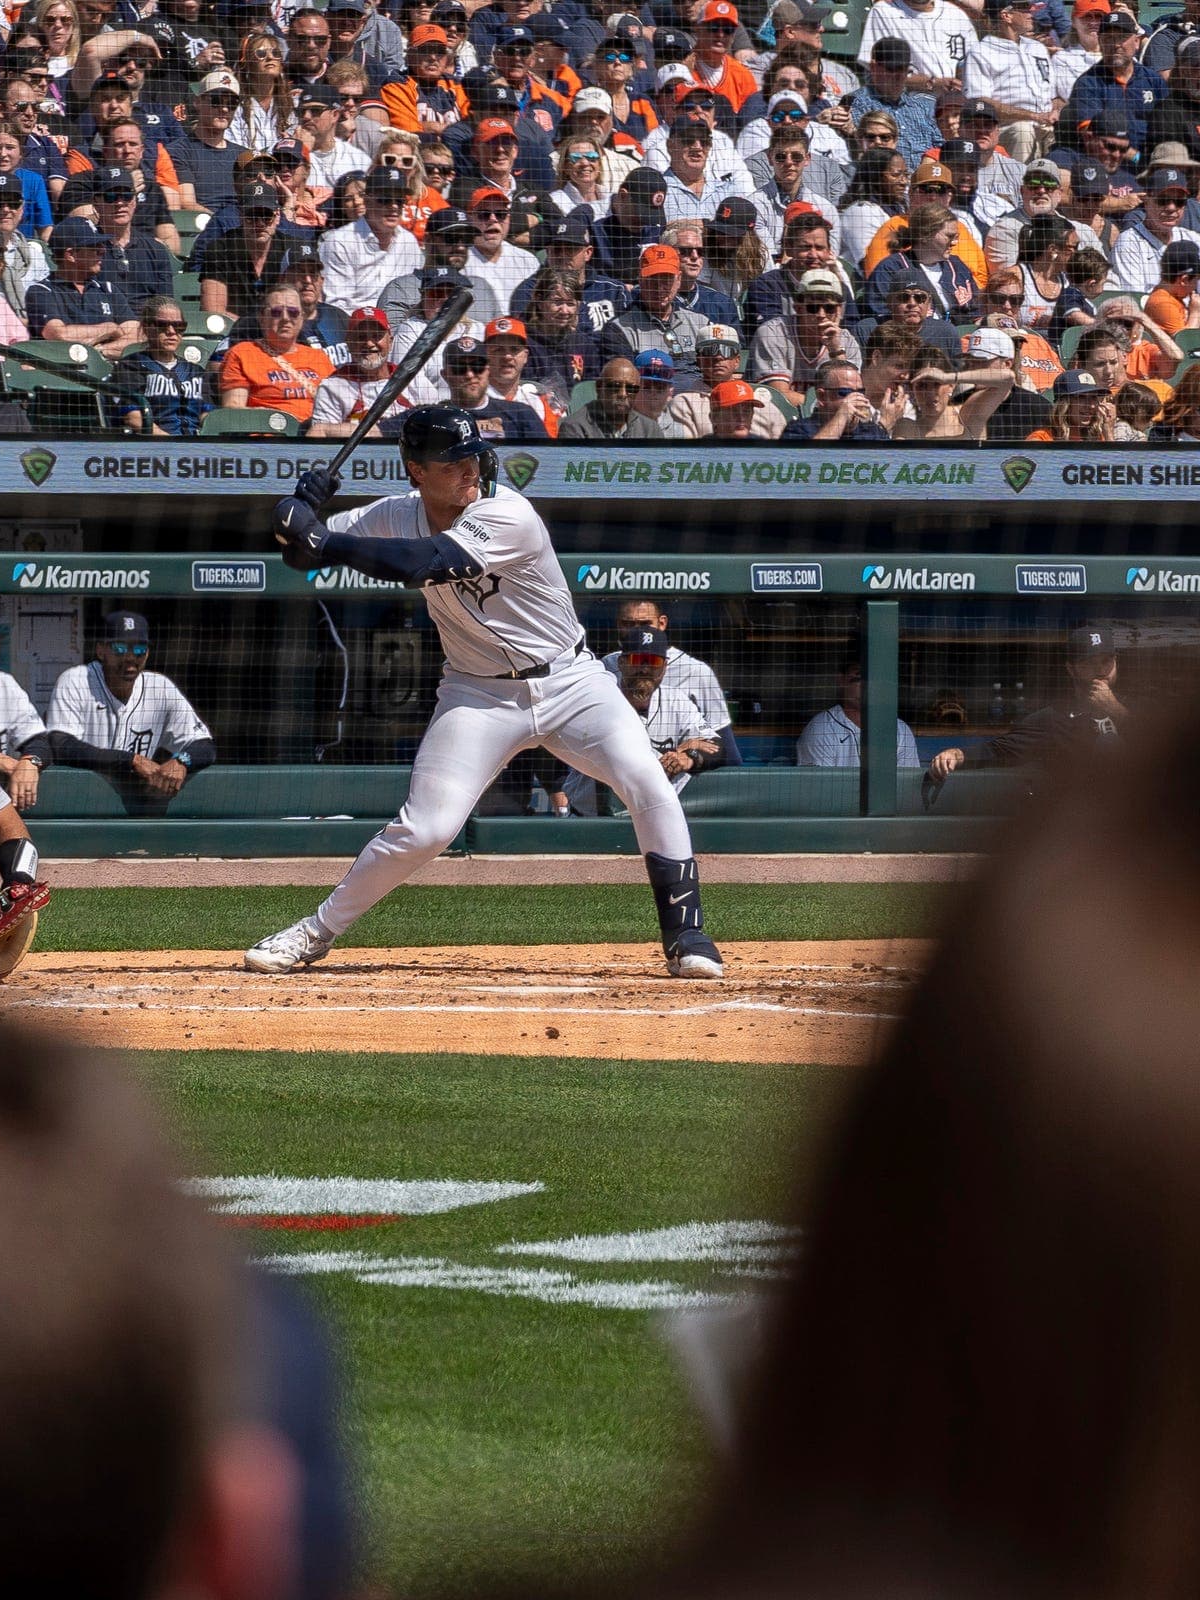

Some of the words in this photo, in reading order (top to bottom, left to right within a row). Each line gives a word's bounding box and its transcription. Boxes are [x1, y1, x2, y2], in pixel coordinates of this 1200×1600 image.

[85, 456, 170, 478] GREEN
[176, 457, 267, 479] SHIELD
[564, 461, 651, 483] NEVER
[658, 461, 733, 484] STAIN
[740, 461, 811, 484] YOUR
[818, 462, 889, 485] DECK
[893, 462, 976, 485] AGAIN
[1062, 464, 1144, 486] GREEN
[460, 519, 492, 543] meijer
[45, 565, 150, 589] Karmanos
[199, 567, 260, 585] TIGERS.COM
[610, 567, 710, 590] Karmanos
[757, 570, 816, 586] TIGERS.COM
[894, 568, 975, 590] McLaren
[1022, 571, 1080, 587] TIGERS.COM
